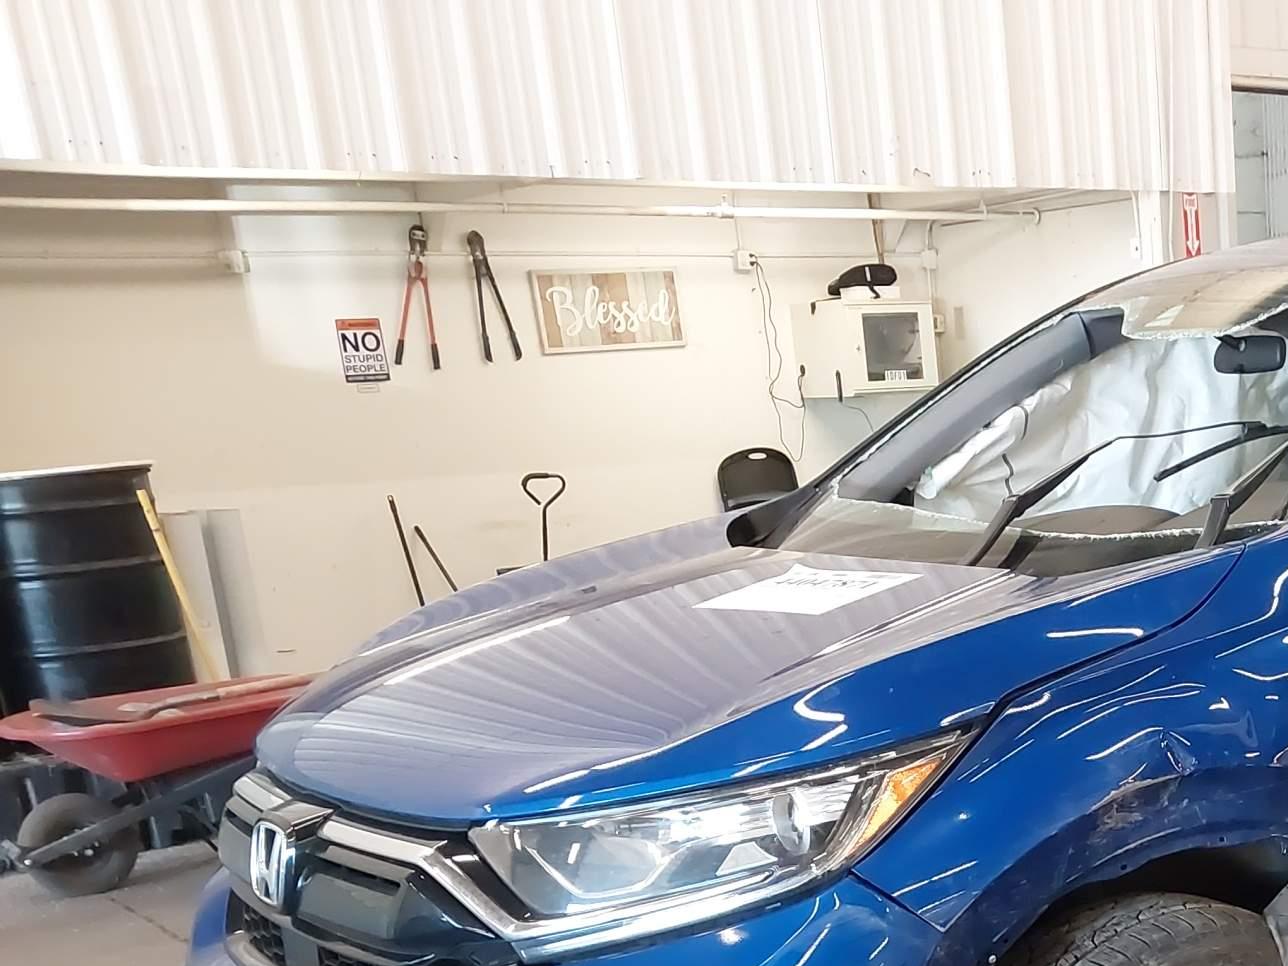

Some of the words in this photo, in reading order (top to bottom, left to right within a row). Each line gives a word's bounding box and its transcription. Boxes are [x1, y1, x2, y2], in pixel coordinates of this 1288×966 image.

[546, 286, 676, 337] Blessed
[340, 331, 381, 353] NO
[344, 353, 384, 364] STUPID
[345, 363, 387, 374] PEOPLE
